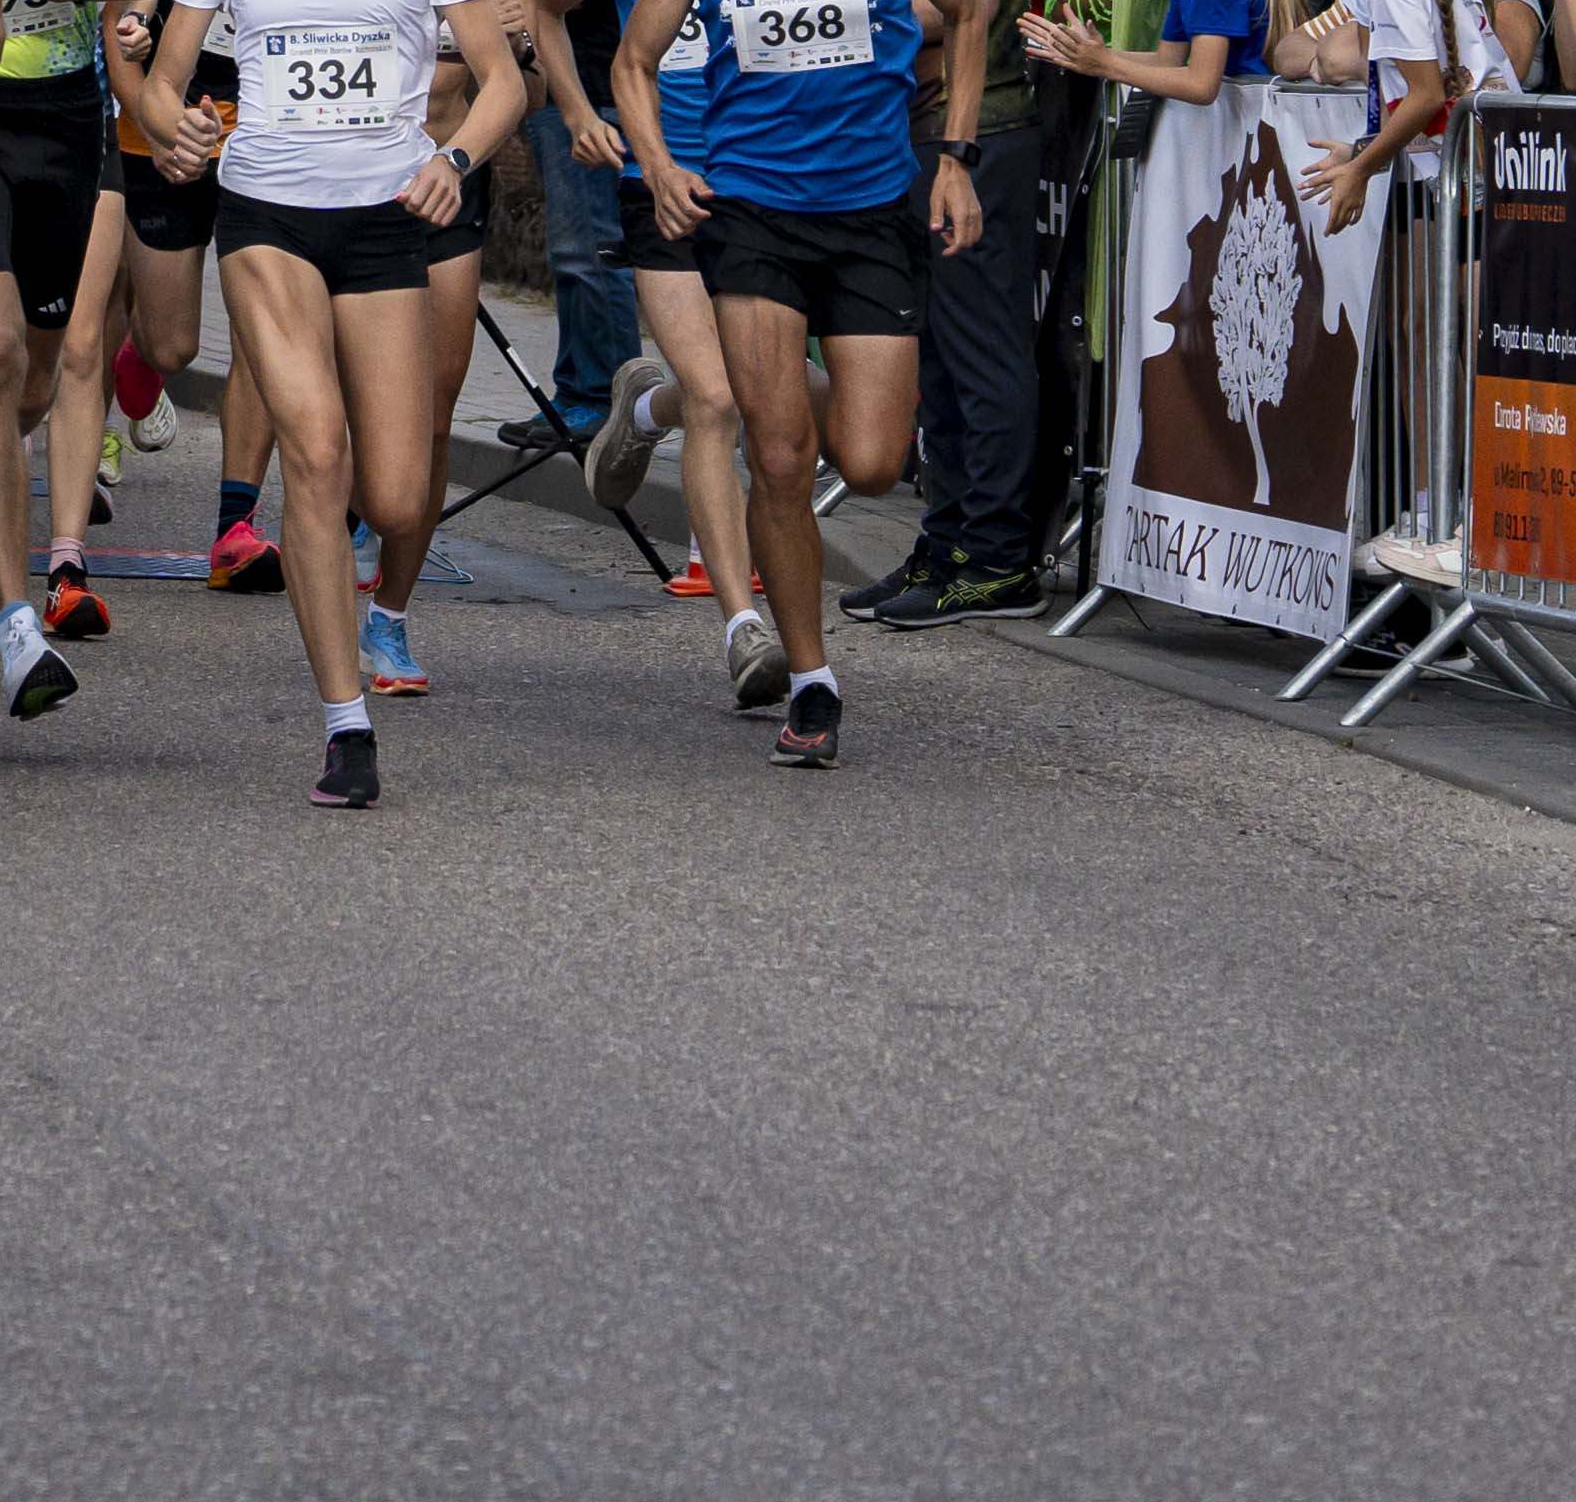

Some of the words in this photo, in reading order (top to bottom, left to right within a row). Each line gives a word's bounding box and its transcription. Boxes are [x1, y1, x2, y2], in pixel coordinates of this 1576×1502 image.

[302, 31, 350, 46] Śliwicka
[351, 30, 391, 44] Dyszka
[758, 3, 846, 48] 368
[287, 57, 378, 102] 334
[1493, 130, 1567, 192] Unilink
